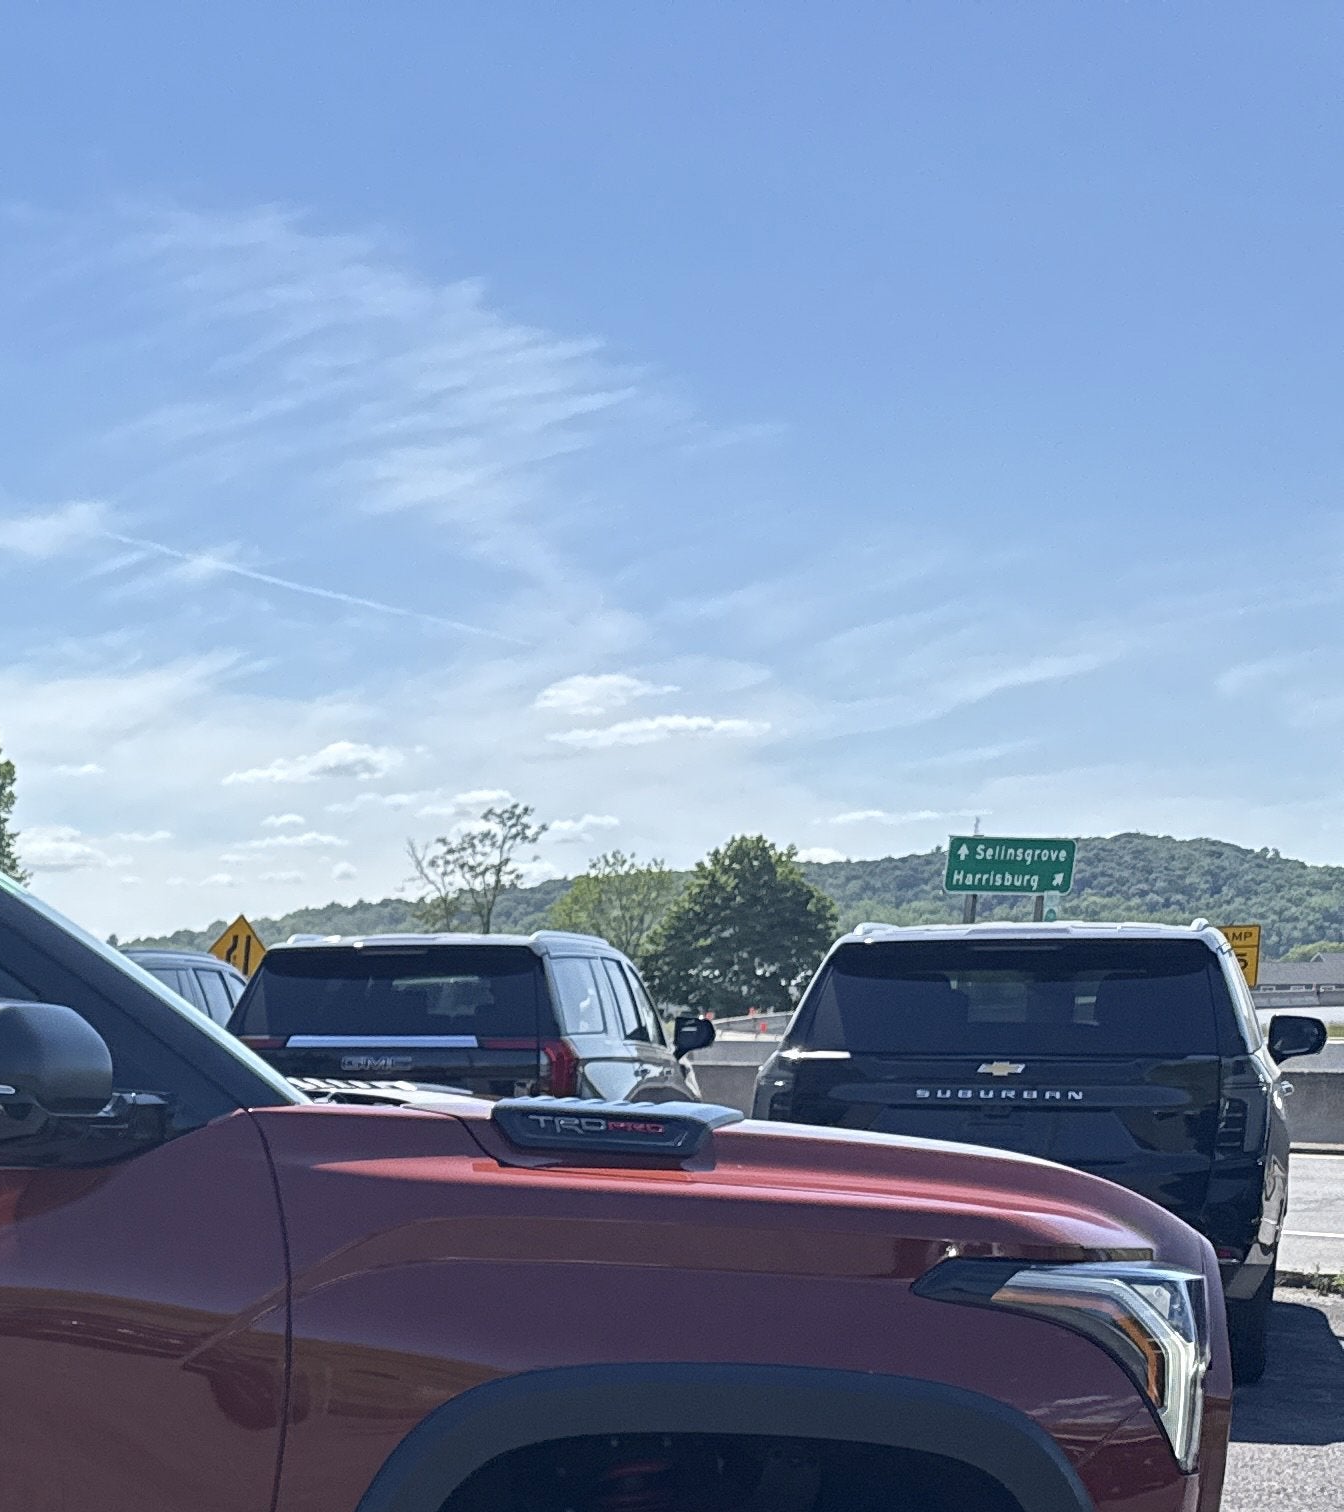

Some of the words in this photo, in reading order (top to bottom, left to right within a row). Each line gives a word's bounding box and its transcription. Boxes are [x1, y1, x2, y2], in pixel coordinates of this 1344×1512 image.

[975, 844, 1067, 866] Selinsgrove
[953, 869, 1039, 890] Harrisburg
[341, 1056, 412, 1071] GMC
[916, 1089, 1083, 1100] SUBURBAN
[528, 1115, 607, 1135] TRD
